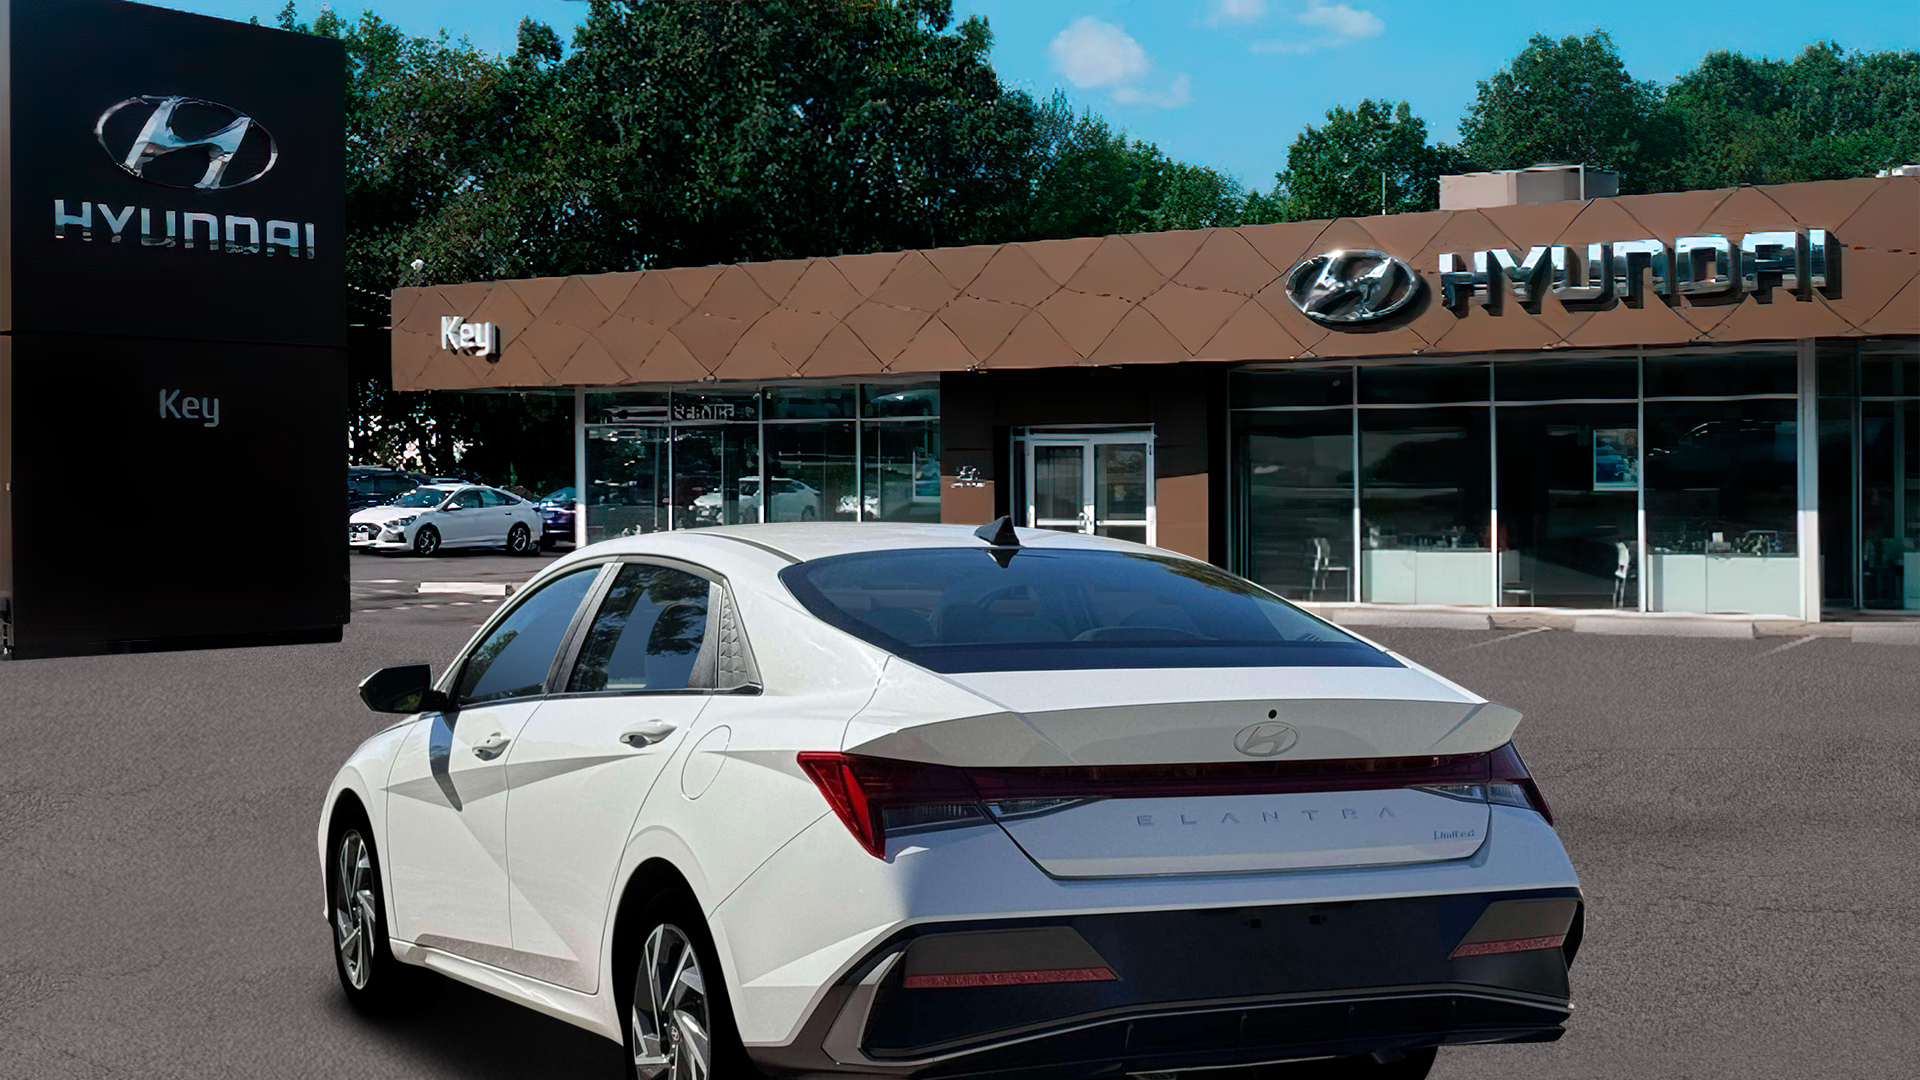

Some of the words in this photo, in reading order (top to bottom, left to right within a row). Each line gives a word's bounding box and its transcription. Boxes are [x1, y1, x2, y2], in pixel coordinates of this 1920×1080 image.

[54, 199, 314, 260] HYUNDAI
[1438, 228, 1836, 312] HYUNDAI
[441, 315, 493, 357] Key
[159, 388, 220, 428] Key
[1136, 807, 1396, 827] ELANTRA
